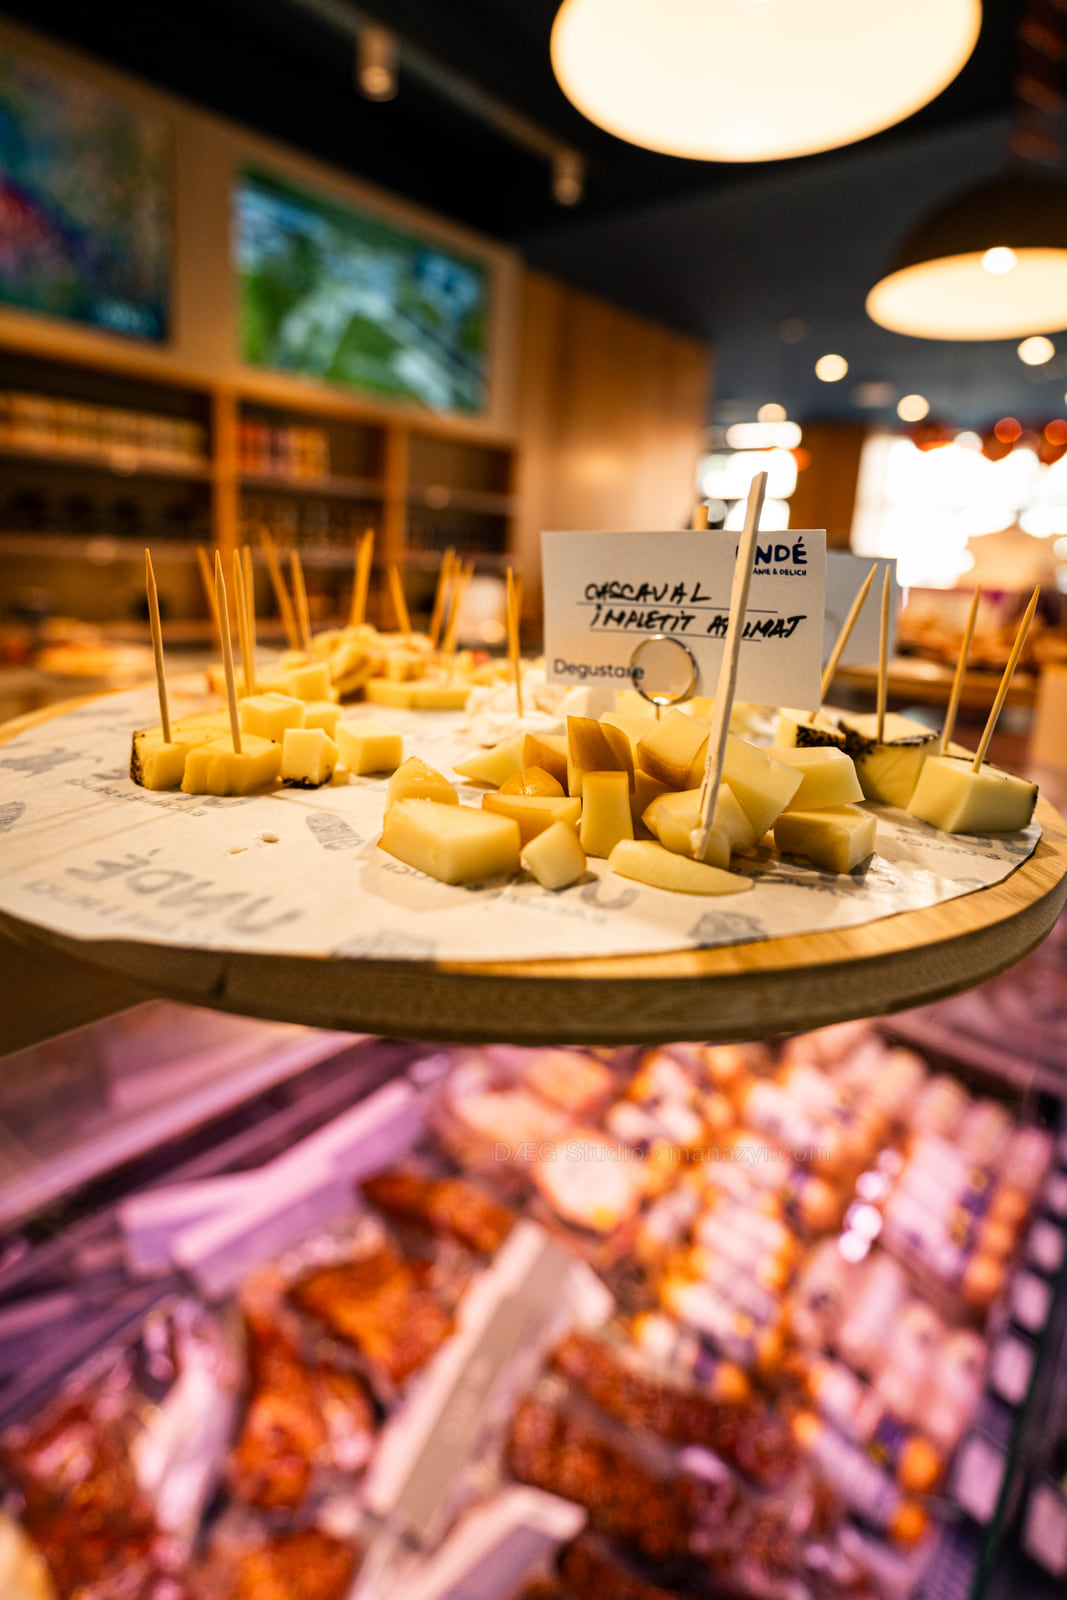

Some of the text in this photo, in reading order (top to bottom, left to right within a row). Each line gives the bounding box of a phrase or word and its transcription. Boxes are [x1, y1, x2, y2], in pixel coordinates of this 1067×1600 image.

[736, 536, 808, 566] NDÉ
[772, 567, 778, 575] &
[779, 568, 807, 577] DELICII
[553, 658, 645, 680] Degustare
